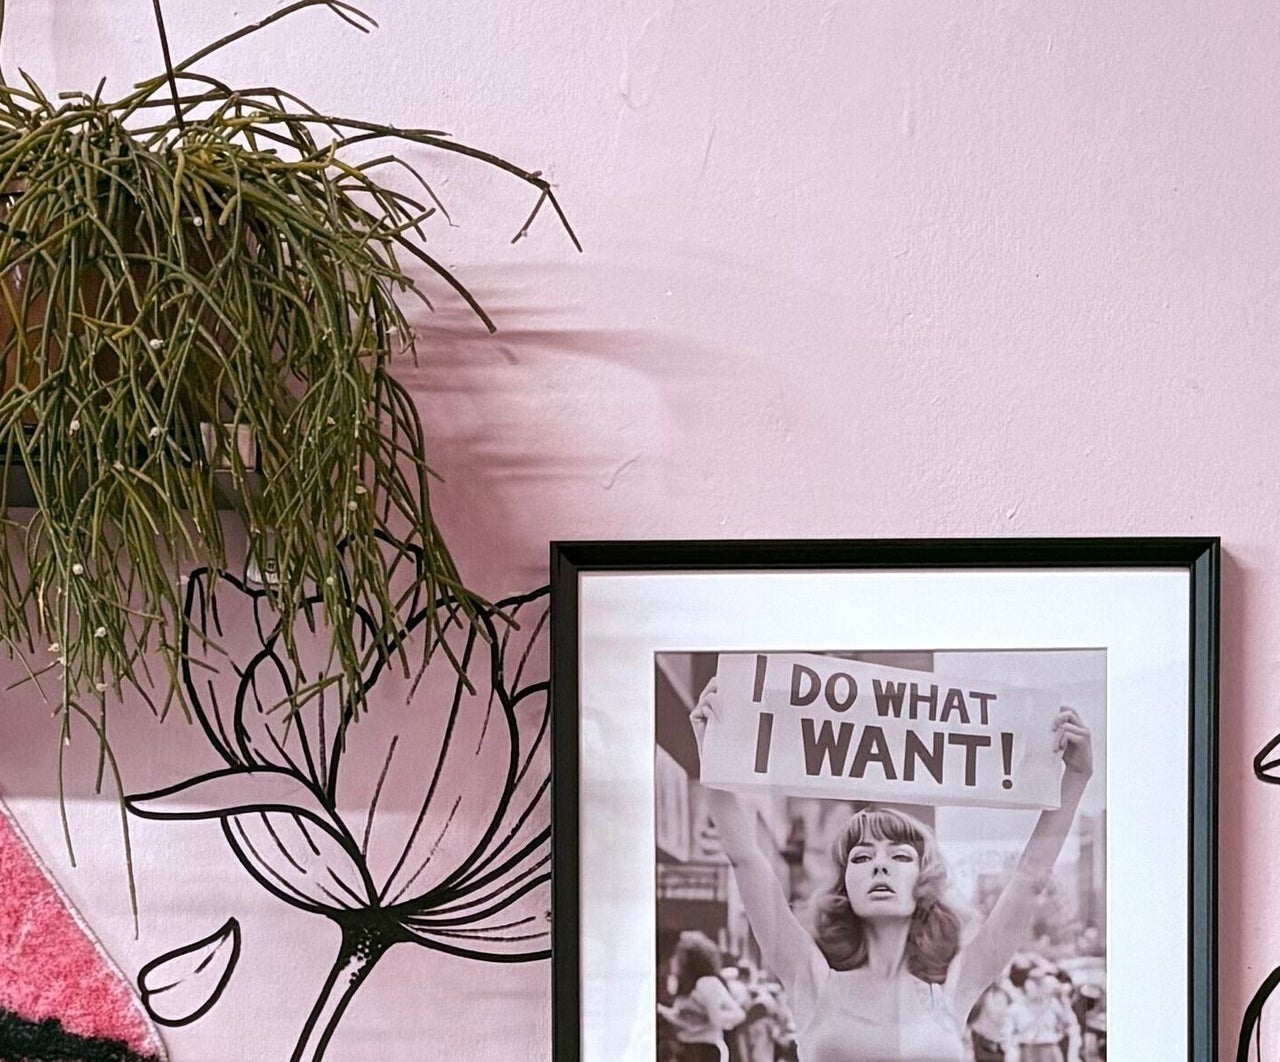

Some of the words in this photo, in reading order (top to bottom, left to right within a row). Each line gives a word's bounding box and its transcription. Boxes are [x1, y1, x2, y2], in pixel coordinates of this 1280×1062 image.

[753, 654, 768, 703] I
[789, 663, 858, 713] DO
[872, 678, 998, 726] WHAT
[754, 712, 774, 774] I
[800, 717, 1015, 790] WANT!
